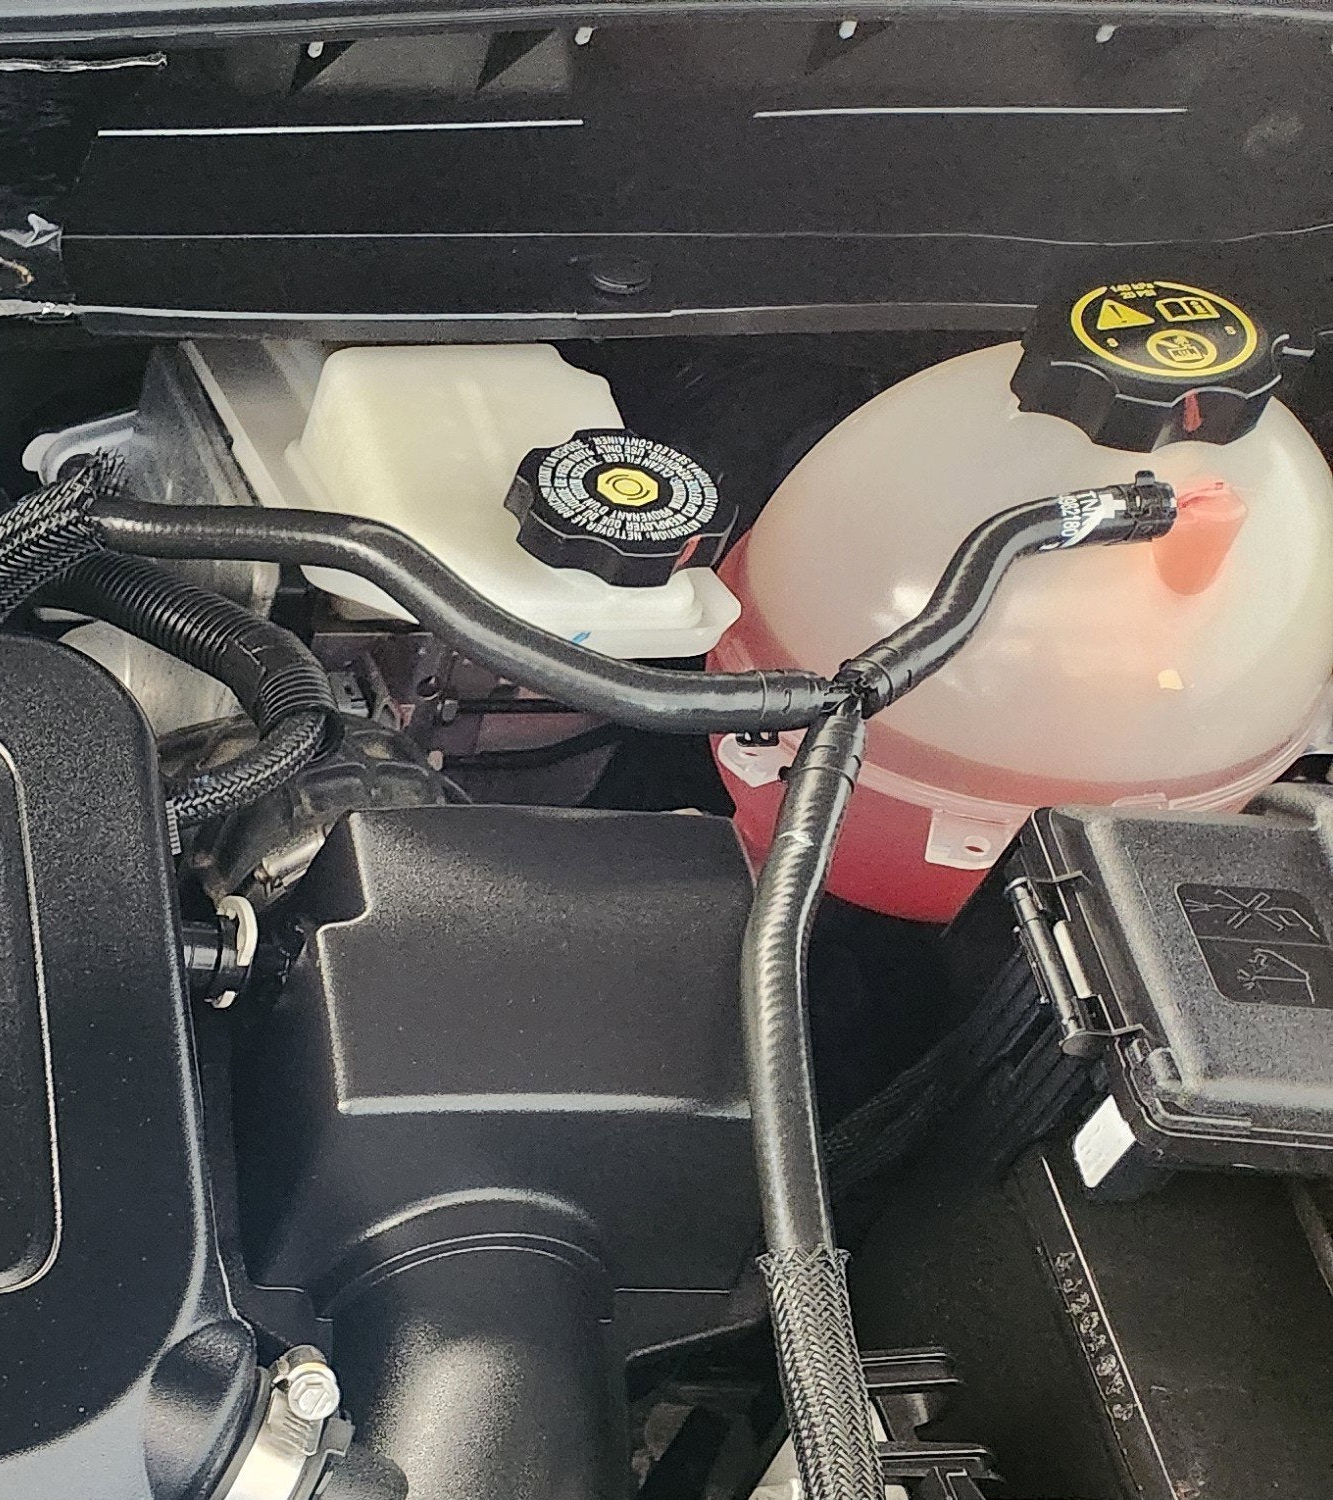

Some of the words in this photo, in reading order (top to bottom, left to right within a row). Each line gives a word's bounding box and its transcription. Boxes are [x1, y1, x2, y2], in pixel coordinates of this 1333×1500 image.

[596, 444, 622, 455] ONLY
[624, 445, 645, 455] USE
[654, 443, 692, 467] SEALED
[602, 453, 642, 464] FILLER
[639, 457, 674, 478] CLEAN
[583, 499, 609, 513] D'UN
[582, 510, 598, 520] DU
[609, 507, 672, 522] PROVENANT
[571, 515, 588, 527] LE
[601, 516, 622, 528] QUE
[585, 522, 642, 540] NETTOYER
